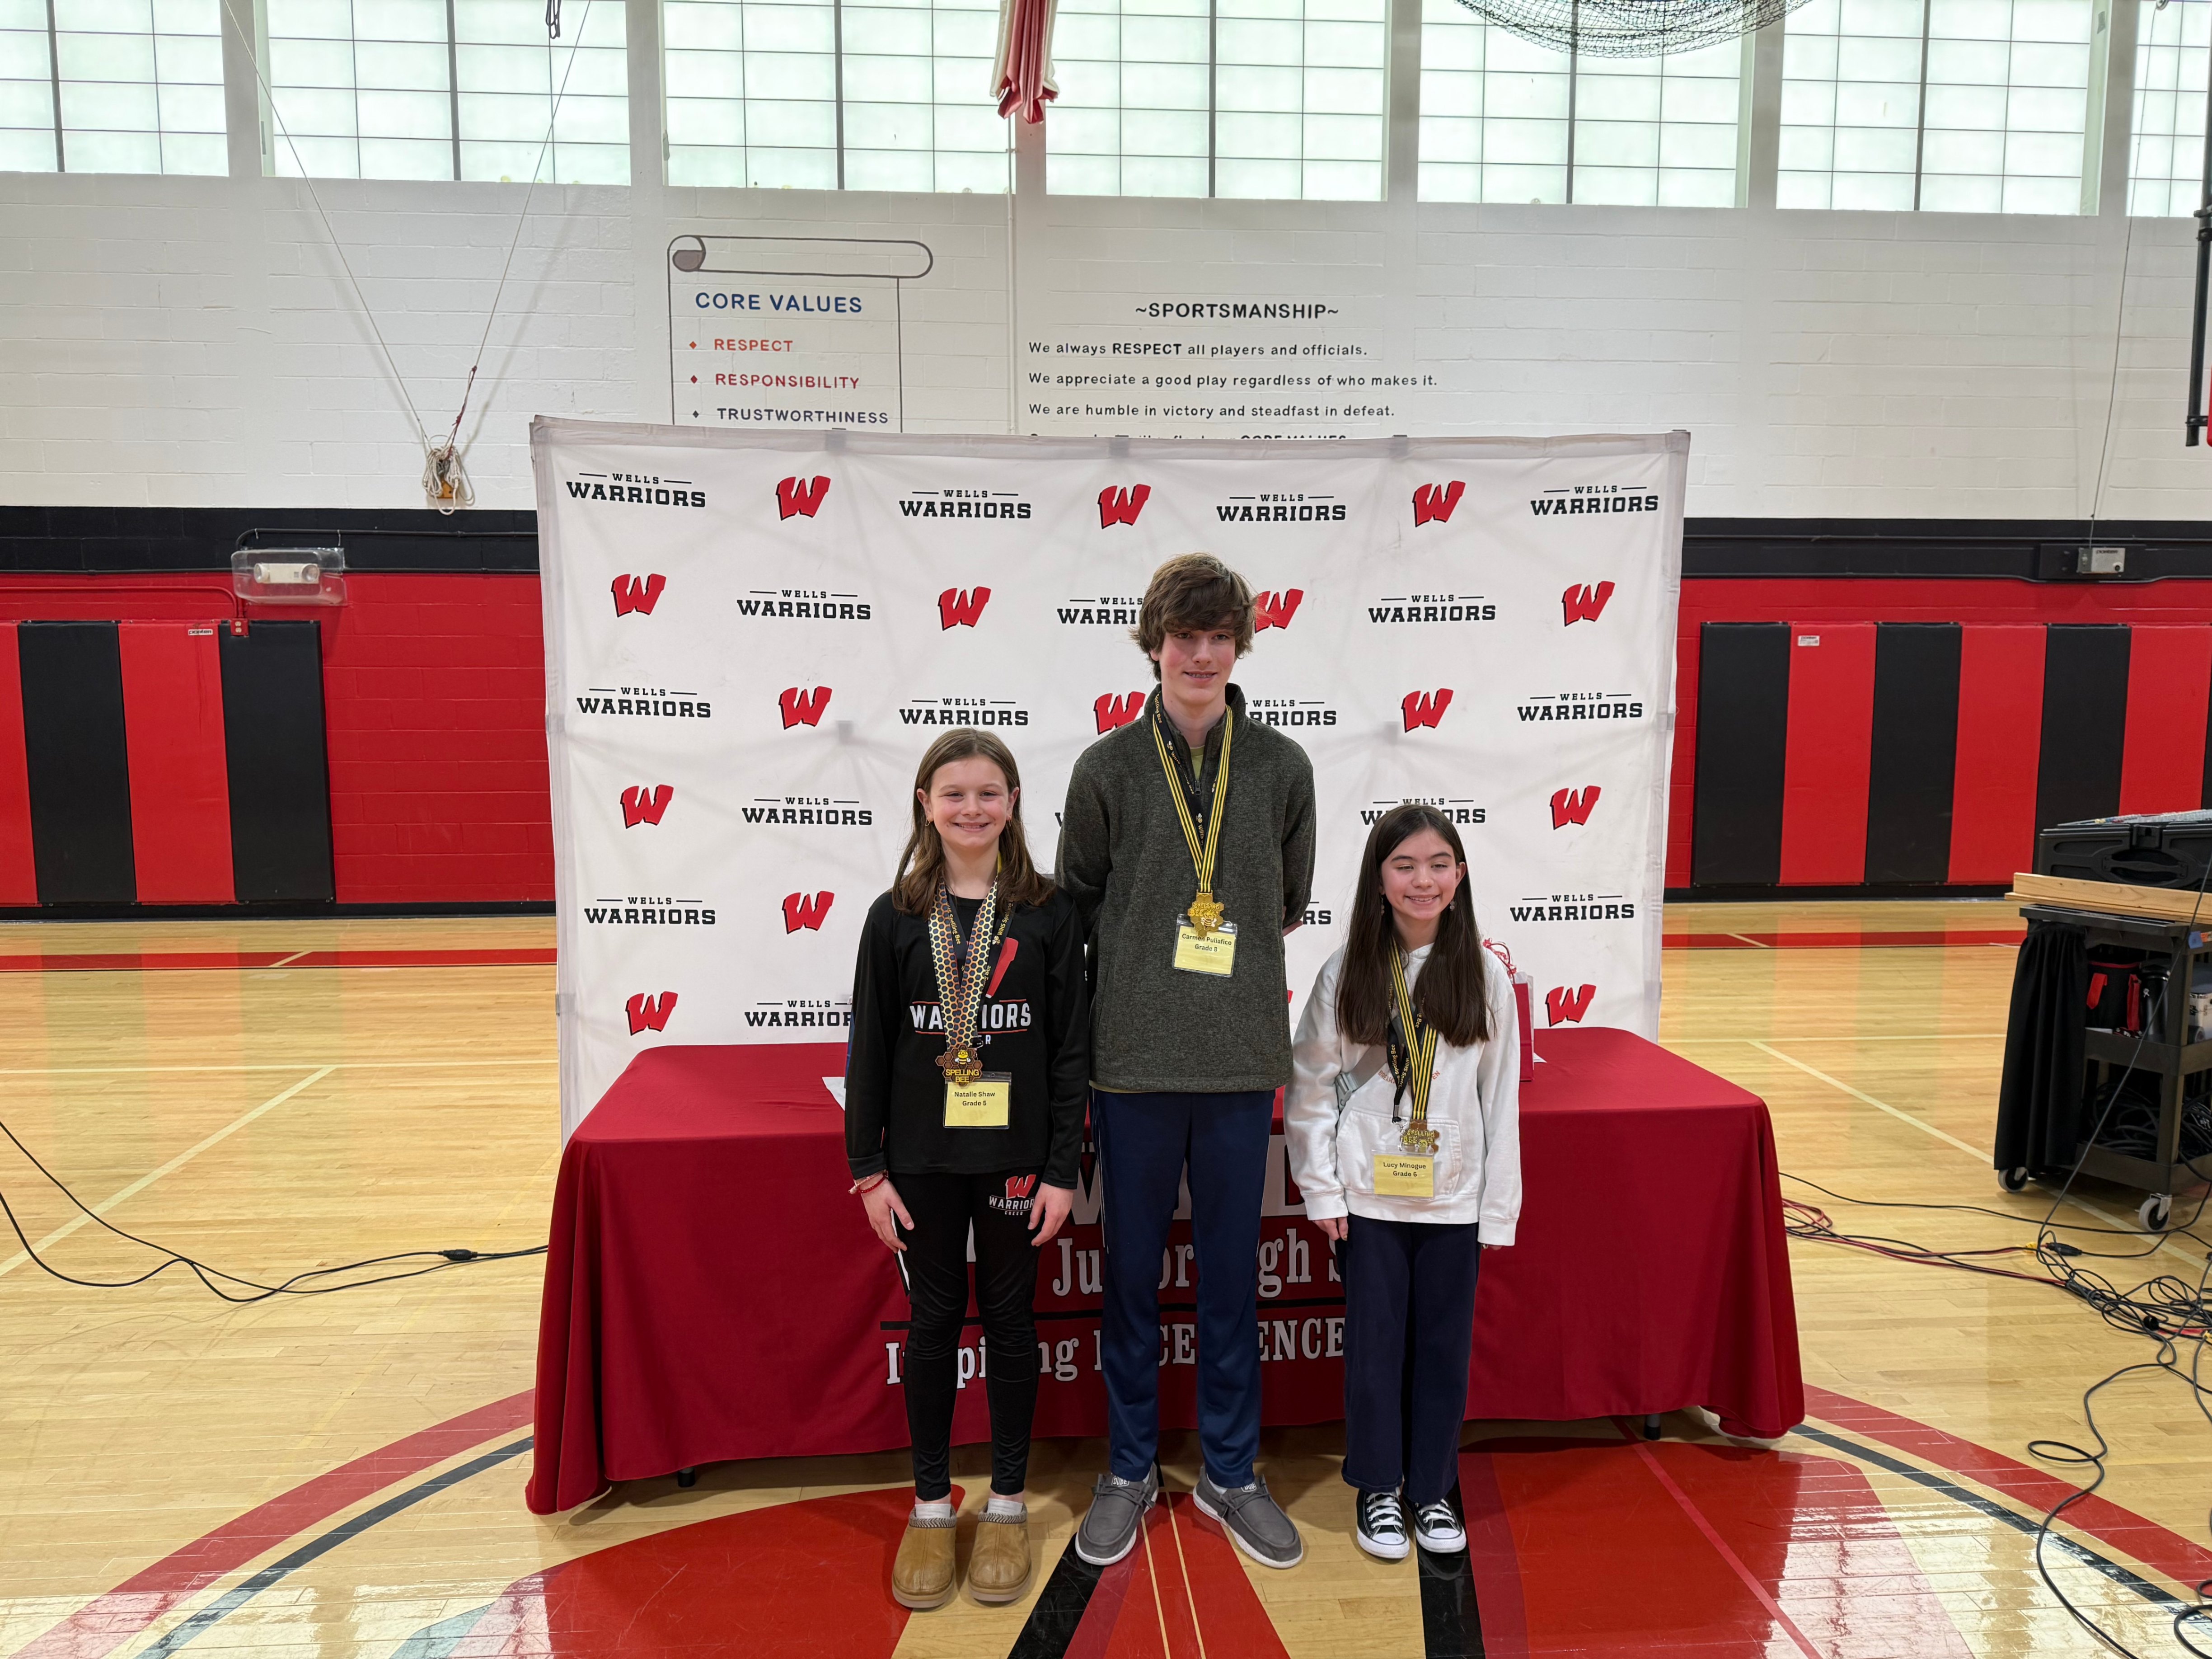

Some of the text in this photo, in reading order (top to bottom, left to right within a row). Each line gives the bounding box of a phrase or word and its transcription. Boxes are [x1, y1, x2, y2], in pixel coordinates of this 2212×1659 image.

[696, 293, 861, 312] CORE VALUES
[715, 339, 792, 352] RESPECT
[1029, 342, 1366, 357] We always RESPECT all players and officials.
[716, 374, 858, 389] RESPONSIBILITY
[1029, 373, 1050, 383] We
[1057, 374, 1135, 386] appreciate
[1156, 375, 1190, 387] good
[1197, 376, 1227, 388] play
[1234, 375, 1310, 388] regardless
[1318, 375, 1331, 385] of
[1337, 376, 1364, 385] who
[1372, 376, 1417, 385] makes
[1424, 376, 1436, 385] it.
[717, 409, 888, 423] TRUSTWORTHINESS
[1029, 404, 1050, 414] We
[1087, 404, 1139, 415] humble
[1145, 406, 1156, 415] in
[1163, 406, 1213, 418] victory
[1220, 405, 1244, 416] and
[1252, 405, 1319, 416] steadfast
[1344, 405, 1393, 416] defeat.
[613, 474, 658, 484] WELLS
[567, 482, 705, 507] WARRIORS
[776, 476, 830, 521] W
[900, 501, 1031, 518] WARRIORS
[1097, 484, 1151, 529] W
[1412, 481, 1465, 527] W
[1531, 496, 1658, 515] WARRIORS
[1217, 505, 1345, 521] WARRIORS
[611, 574, 666, 617] W
[782, 590, 826, 598] WELLS
[737, 600, 870, 620] WARRIORS
[938, 587, 991, 630] W
[1562, 581, 1615, 626] W
[1057, 609, 1136, 624] WARRI
[1368, 606, 1495, 623] WARRIORS
[621, 687, 665, 696] WELLS
[577, 698, 710, 718] WARRIORS
[778, 686, 832, 729] W
[1401, 688, 1453, 733] W
[1518, 703, 1642, 721] WARRIORS
[900, 709, 1028, 725] WARRIORS
[1250, 711, 1336, 726] RRIORS
[620, 785, 674, 829] W
[1550, 786, 1601, 830] W
[742, 808, 872, 825] WARRIORS
[584, 908, 715, 924] WARRIORS
[782, 891, 834, 934] W
[1510, 904, 1634, 921] WARRIORS
[1182, 933, 1205, 941] Carmen
[625, 992, 678, 1036] W
[1545, 984, 1596, 1027] W
[910, 1003, 1031, 1029] WAIORS
[989, 1196, 1035, 1210] WARRIOR
